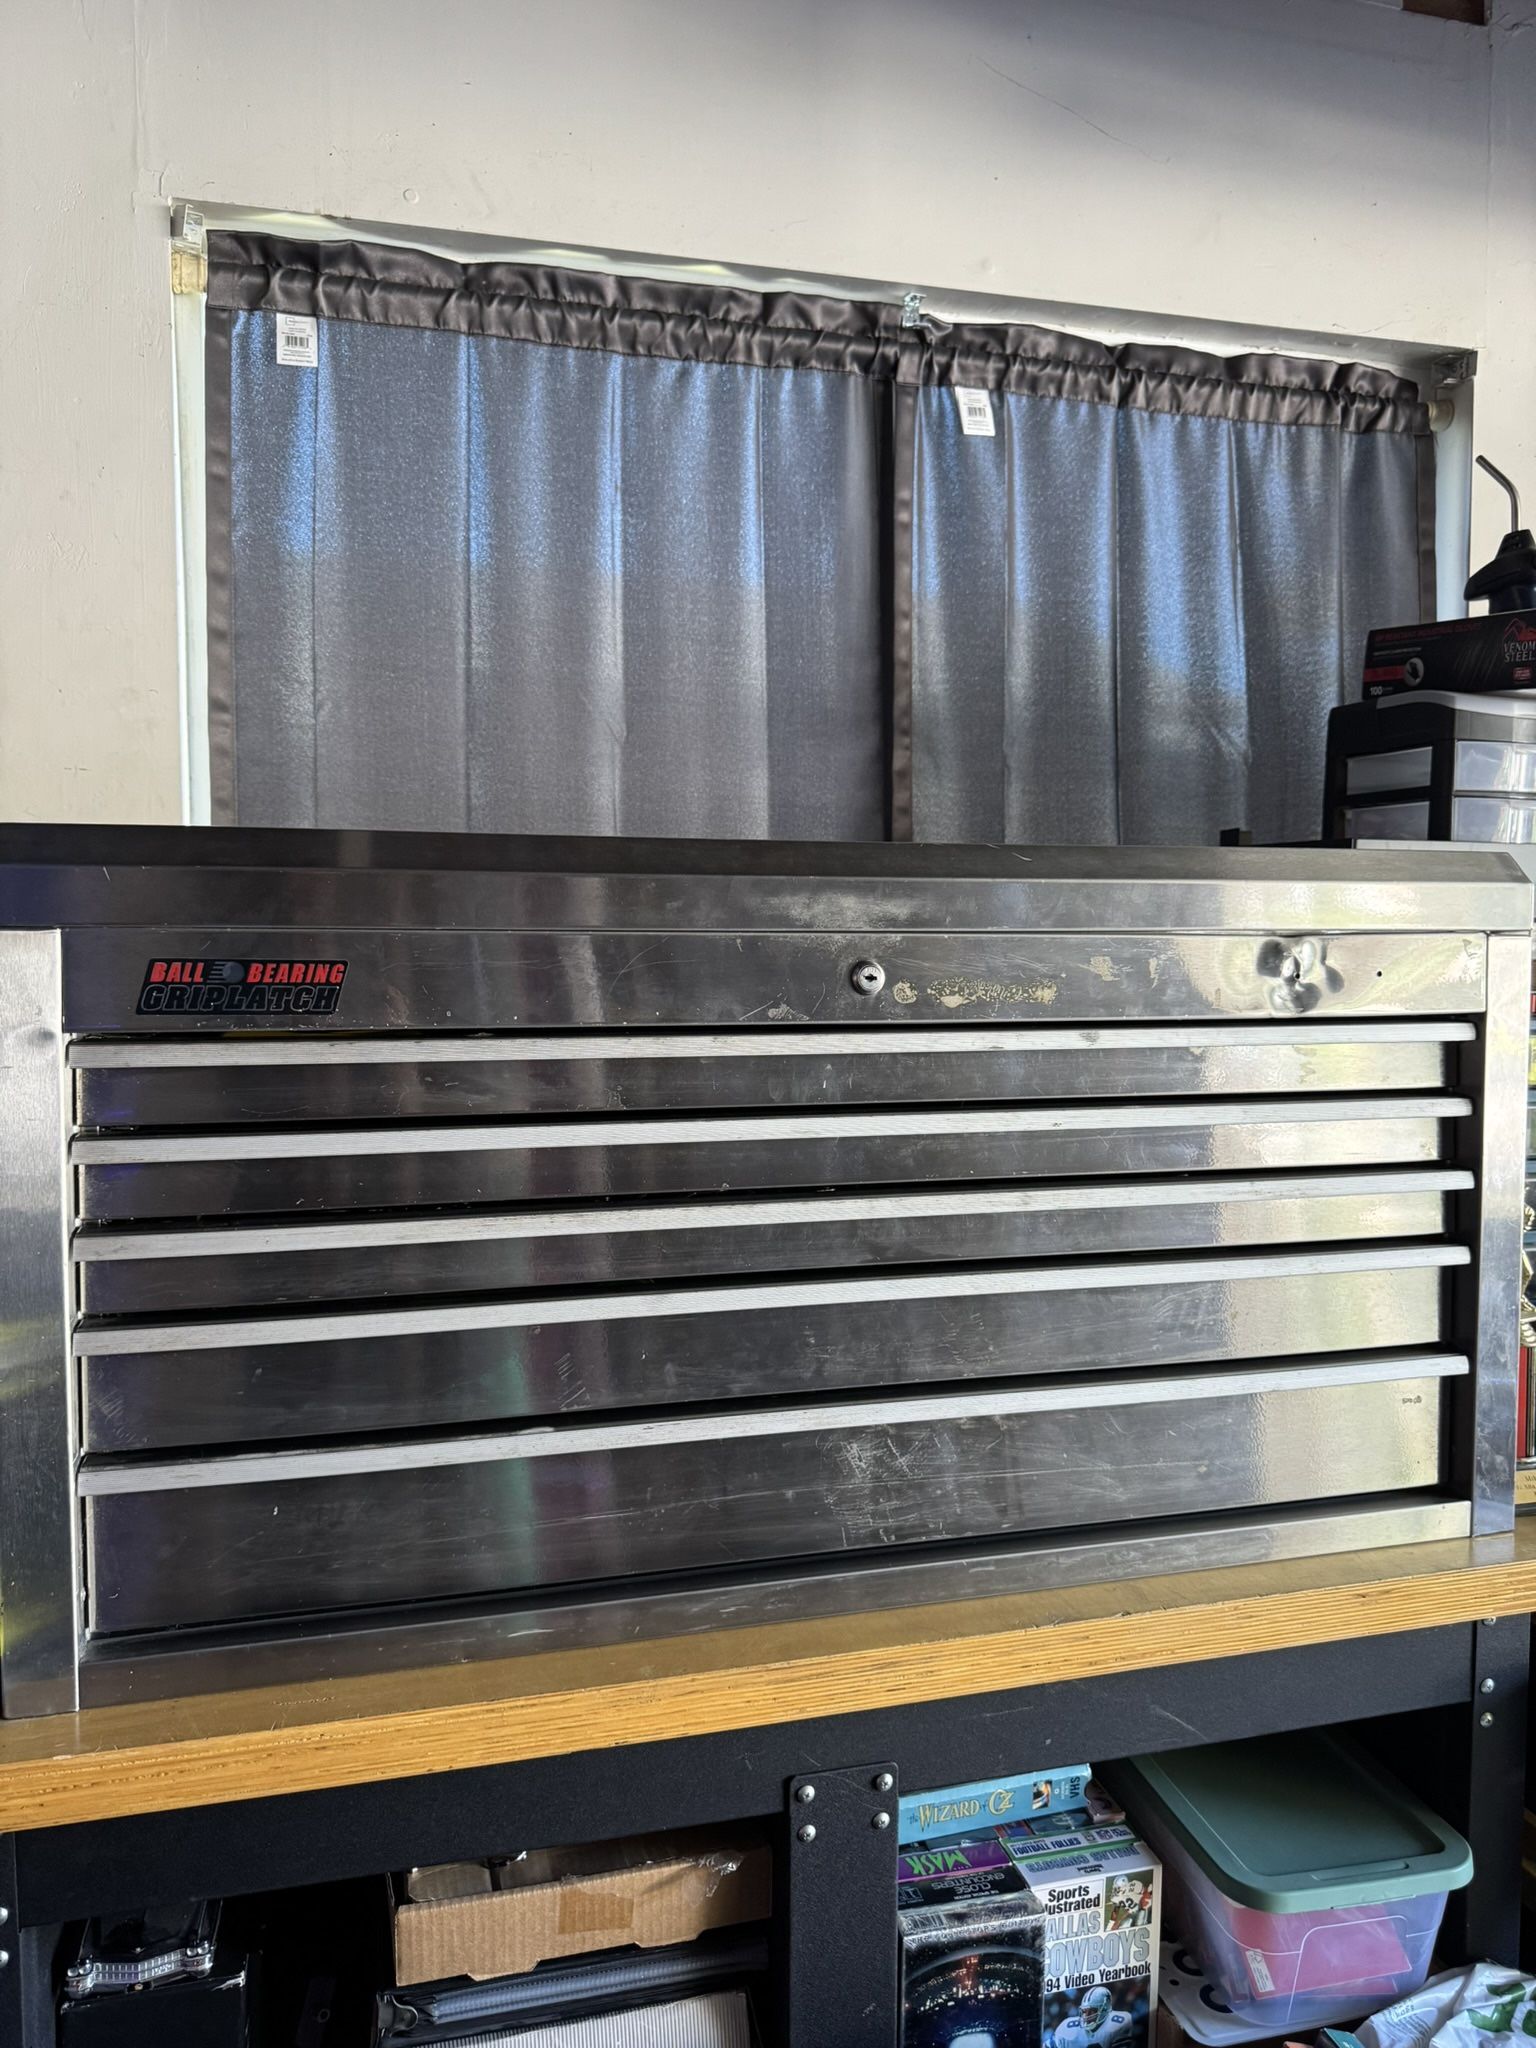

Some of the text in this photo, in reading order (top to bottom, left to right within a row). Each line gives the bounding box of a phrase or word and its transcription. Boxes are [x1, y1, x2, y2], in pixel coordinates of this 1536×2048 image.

[1370, 686, 1383, 695] 100
[151, 962, 344, 983] BALL BEARING
[141, 985, 339, 1011] GRIPLATCH
[1070, 1776, 1081, 1799] VHS
[919, 1799, 980, 1832] WIZARD
[1011, 1841, 1051, 1856] FOOTBALL
[1051, 1837, 1082, 1849] FOLLIES
[904, 1850, 972, 1876] MASK
[931, 1872, 1006, 1891] ENCOUNTERS
[953, 1881, 991, 1895] CLOSE
[1045, 1893, 1100, 1915] lustrated
[1047, 1885, 1090, 1903] Sports
[1045, 1911, 1101, 1942] ALLAS
[1065, 1973, 1095, 1988] Video
[1099, 1961, 1151, 1982] Yearbook
